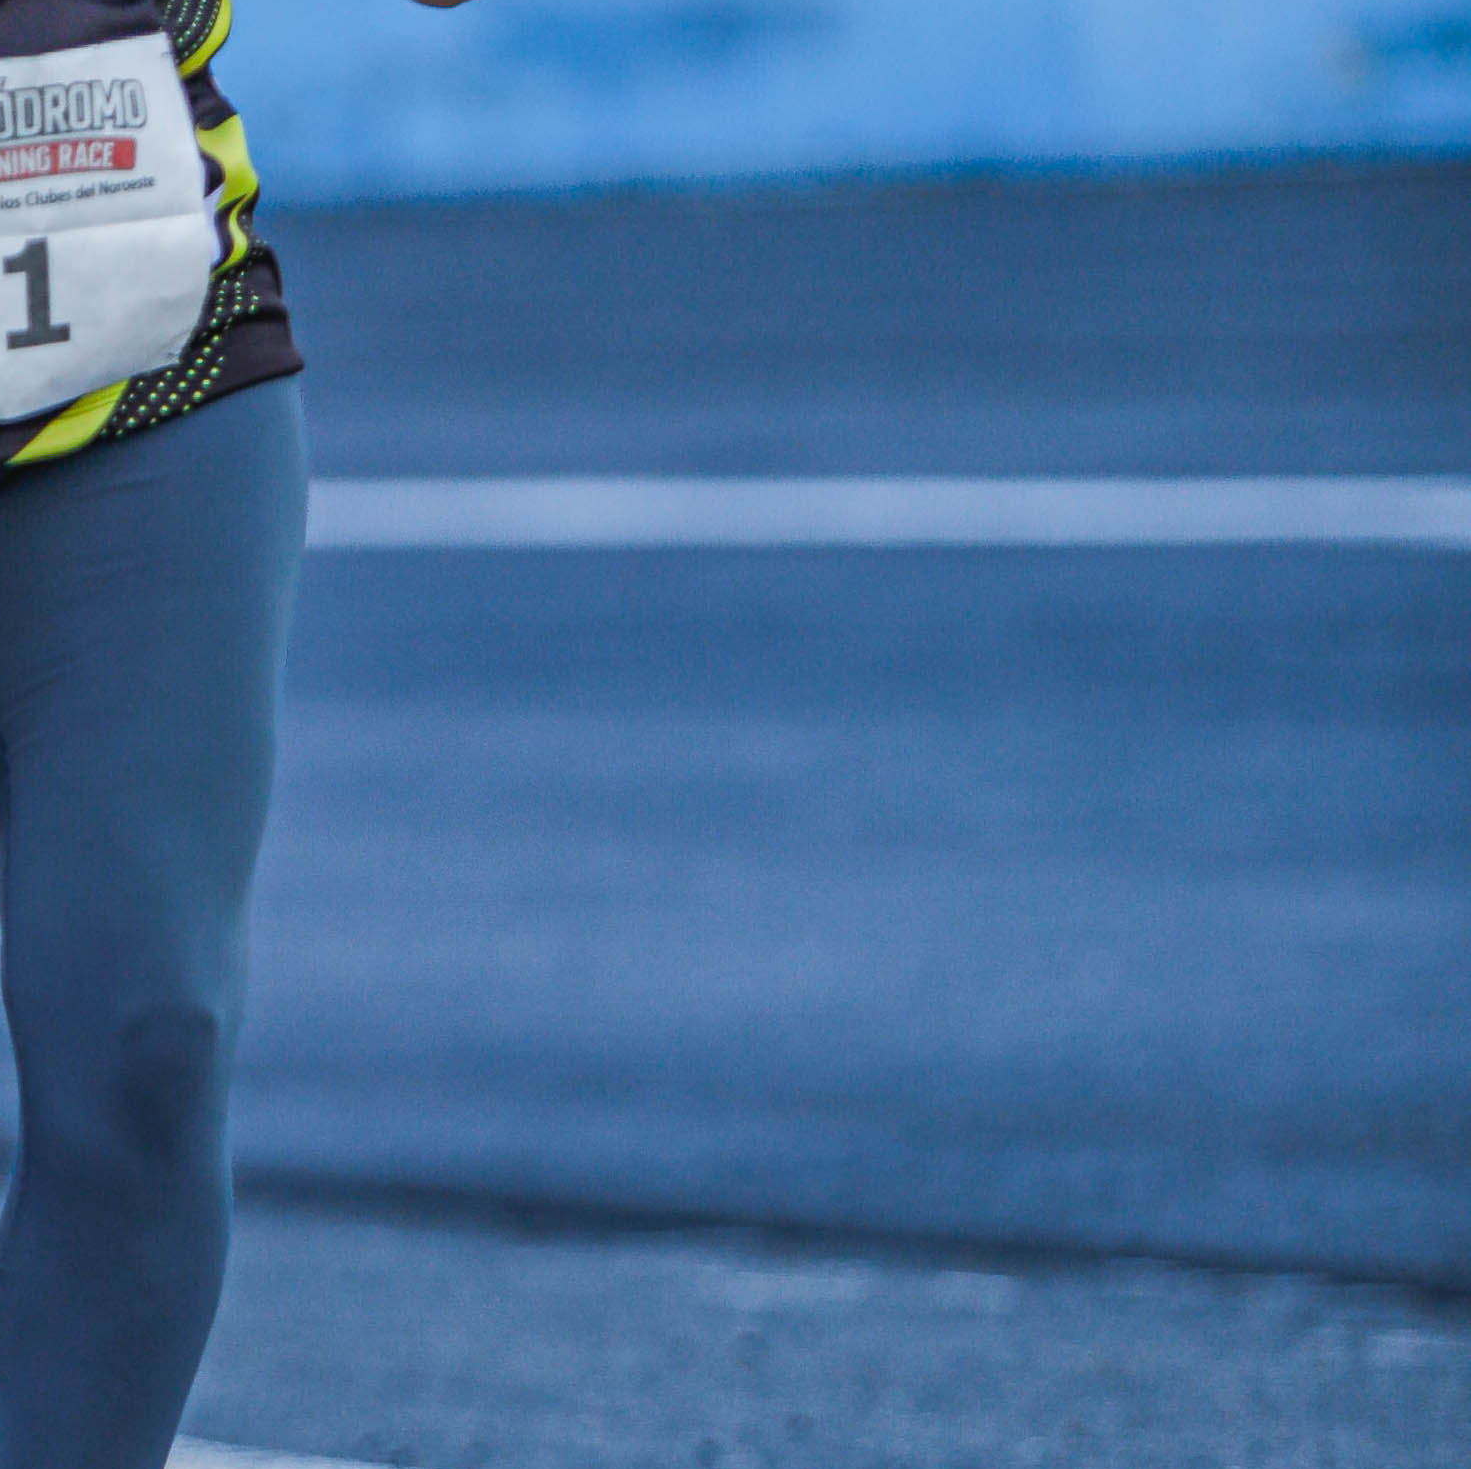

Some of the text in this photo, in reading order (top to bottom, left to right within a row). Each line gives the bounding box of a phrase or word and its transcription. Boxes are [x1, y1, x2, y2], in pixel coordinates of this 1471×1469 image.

[59, 141, 115, 171] RACE
[0, 193, 21, 209] los
[25, 187, 72, 207] Clubes
[77, 183, 96, 200] del
[99, 174, 156, 196] Noroeste
[3, 236, 70, 351] 1
